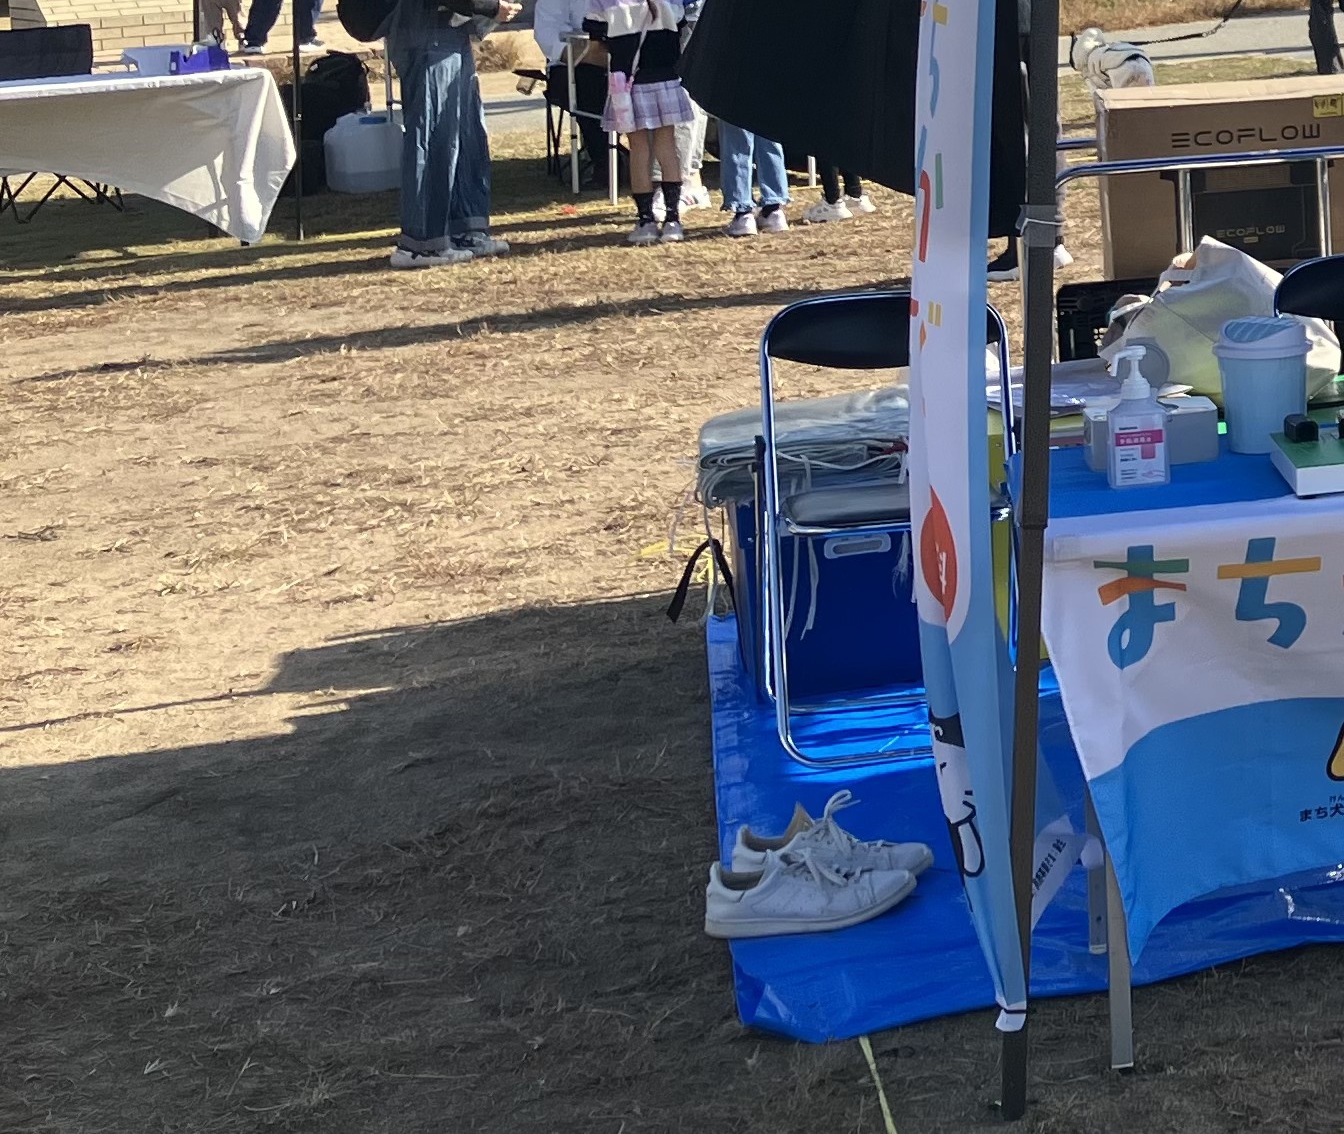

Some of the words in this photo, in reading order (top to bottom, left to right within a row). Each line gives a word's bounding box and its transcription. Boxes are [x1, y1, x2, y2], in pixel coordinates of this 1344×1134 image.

[1171, 123, 1321, 149] ECOFLOW
[1216, 224, 1286, 239] ECOFLOW
[1300, 803, 1344, 822] まち犬
